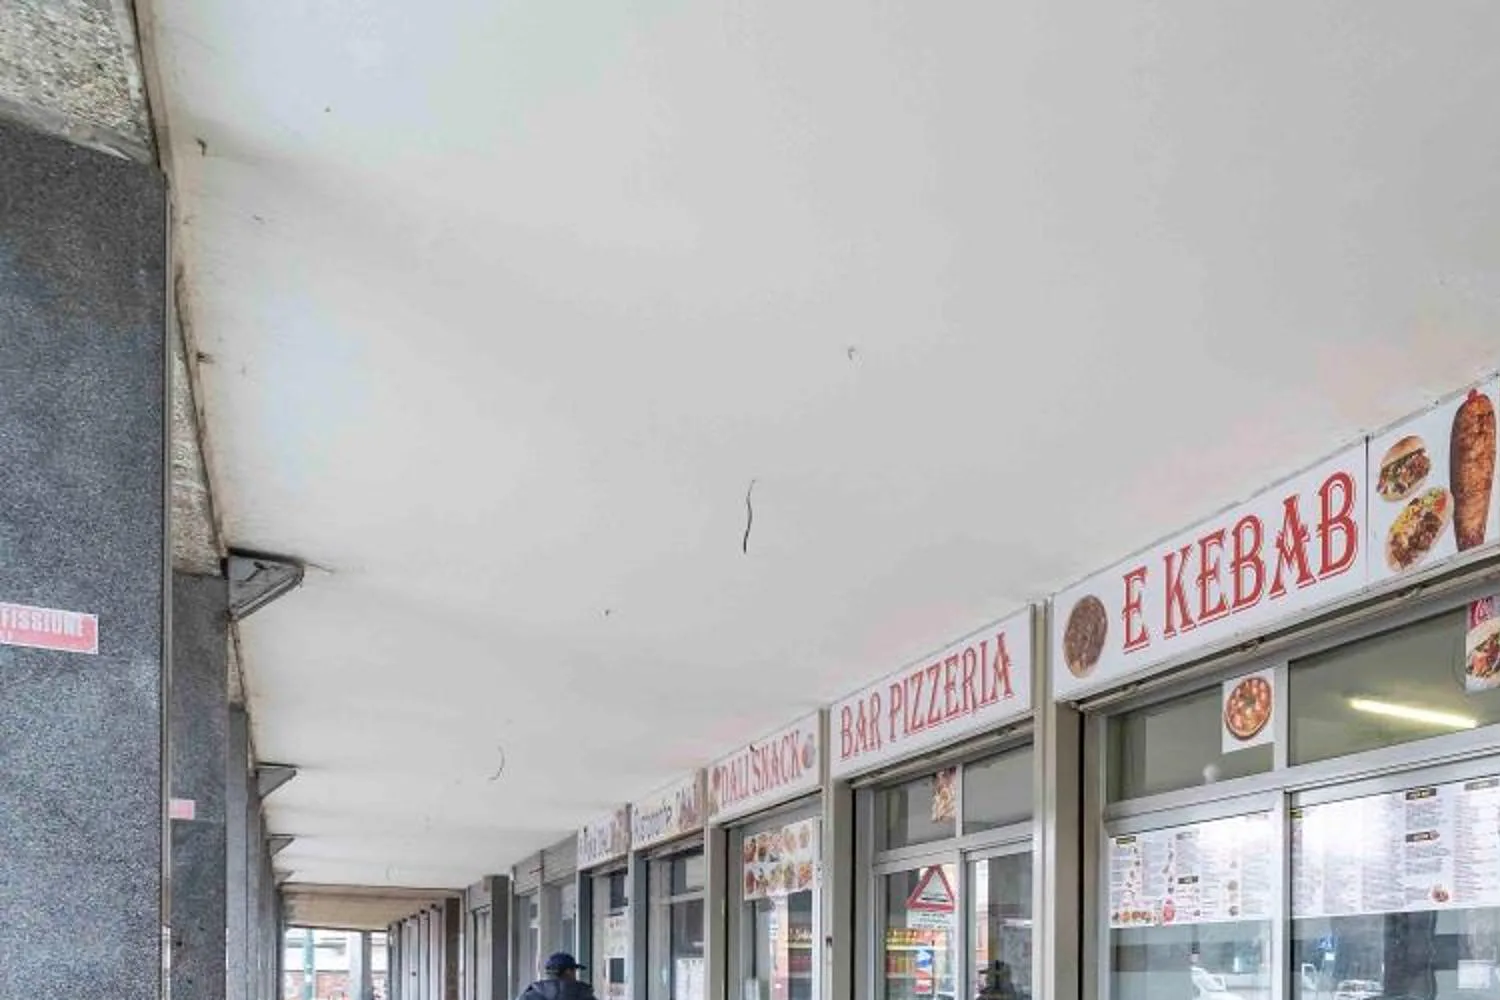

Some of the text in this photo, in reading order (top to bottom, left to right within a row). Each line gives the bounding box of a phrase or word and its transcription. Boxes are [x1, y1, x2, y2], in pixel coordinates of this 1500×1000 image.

[1121, 471, 1360, 654] E KEBAB
[751, 729, 802, 795] SNACK
[840, 631, 1016, 762] BAR PIZZERIA
